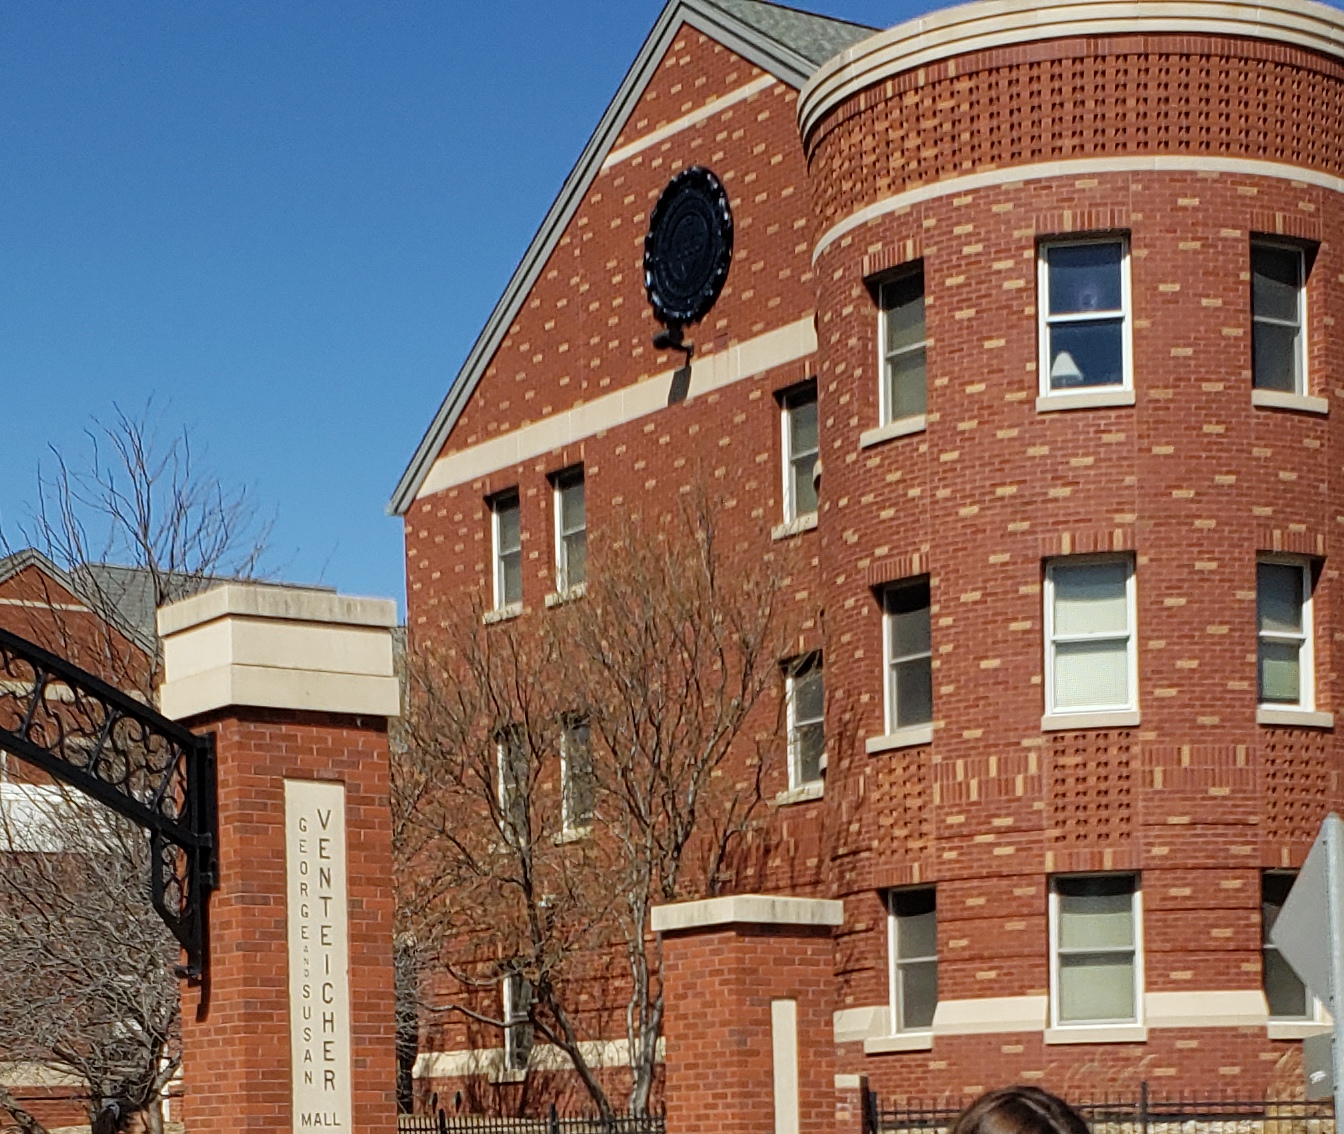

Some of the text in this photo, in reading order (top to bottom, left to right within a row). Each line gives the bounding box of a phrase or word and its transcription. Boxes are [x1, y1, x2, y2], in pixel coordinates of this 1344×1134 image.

[298, 816, 310, 940] GEORGE
[316, 808, 337, 1092] VENTEICHER
[302, 983, 313, 1085] SUSAN
[300, 1111, 342, 1128] MALL
